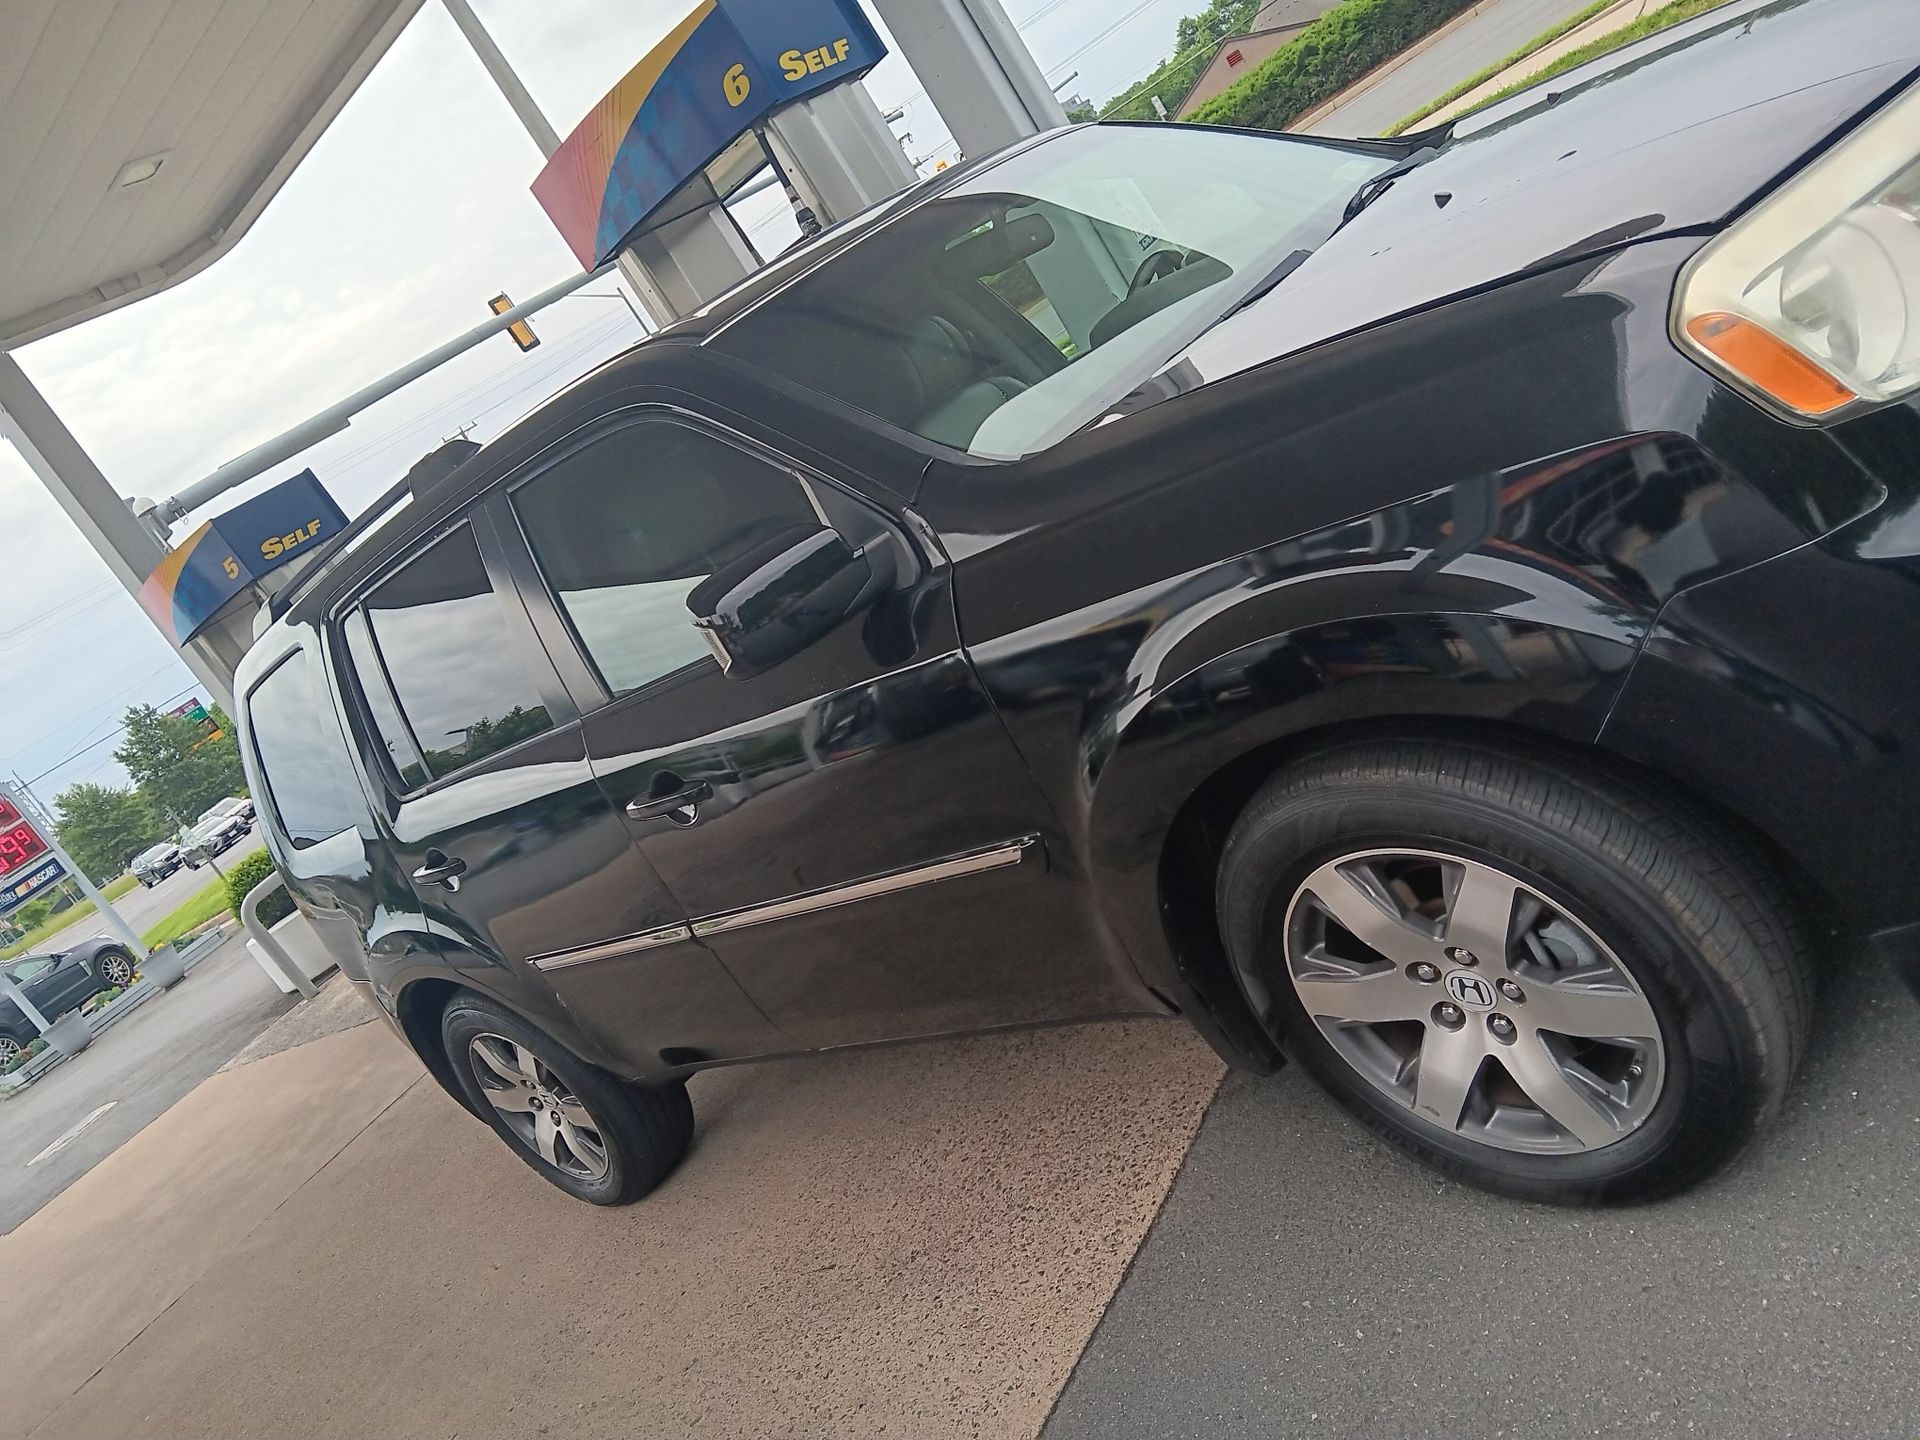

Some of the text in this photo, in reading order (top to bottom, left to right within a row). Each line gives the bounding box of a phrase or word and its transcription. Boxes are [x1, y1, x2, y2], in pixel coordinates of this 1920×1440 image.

[723, 38, 850, 107] 6 SELF
[222, 518, 321, 580] 5 SELF
[29, 863, 58, 888] NASCAR
